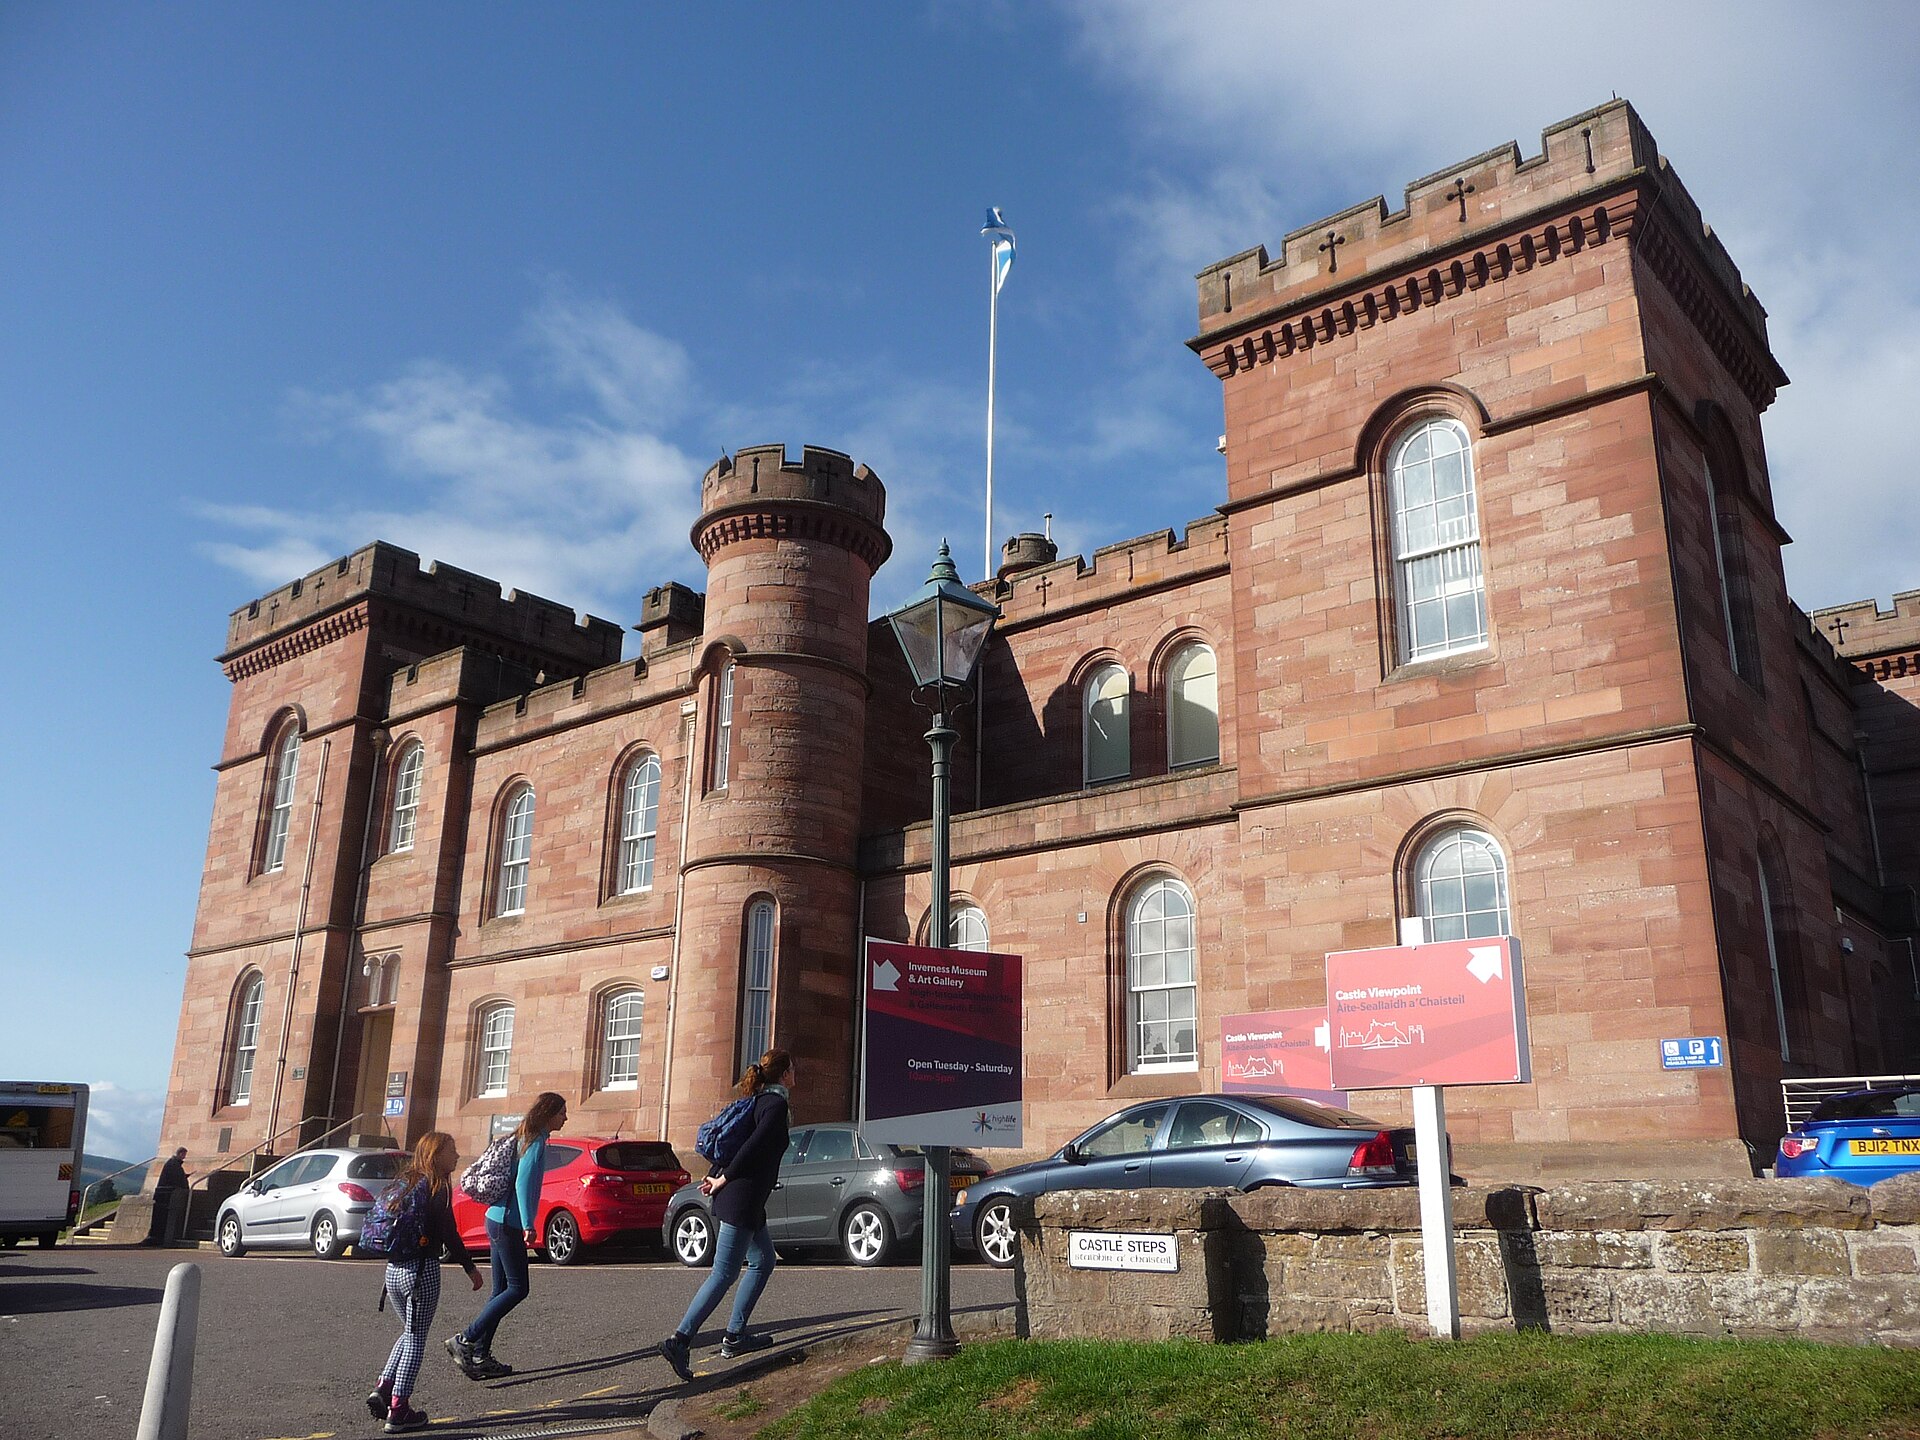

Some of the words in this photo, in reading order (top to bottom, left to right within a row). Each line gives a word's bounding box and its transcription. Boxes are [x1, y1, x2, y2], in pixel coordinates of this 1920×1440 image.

[908, 962, 950, 974] Inverness
[951, 965, 988, 977] Museum
[908, 974, 916, 983] &
[917, 975, 931, 984] Art
[932, 976, 964, 989] Gallery
[1335, 989, 1367, 1001] Castle
[1368, 984, 1422, 998] Viewpoint
[1225, 1034, 1247, 1043] Castle
[1247, 1031, 1283, 1041] Viewpoint
[1692, 1042, 1701, 1053] P
[907, 1059, 932, 1070] Open
[933, 1060, 969, 1073] Tuesday
[975, 1062, 1013, 1075] Saturday
[1858, 1141, 1889, 1153] BJ12
[1891, 1140, 1920, 1152] TNX
[1079, 1238, 1123, 1252] CASTLE
[1127, 1240, 1167, 1254] STEPS
